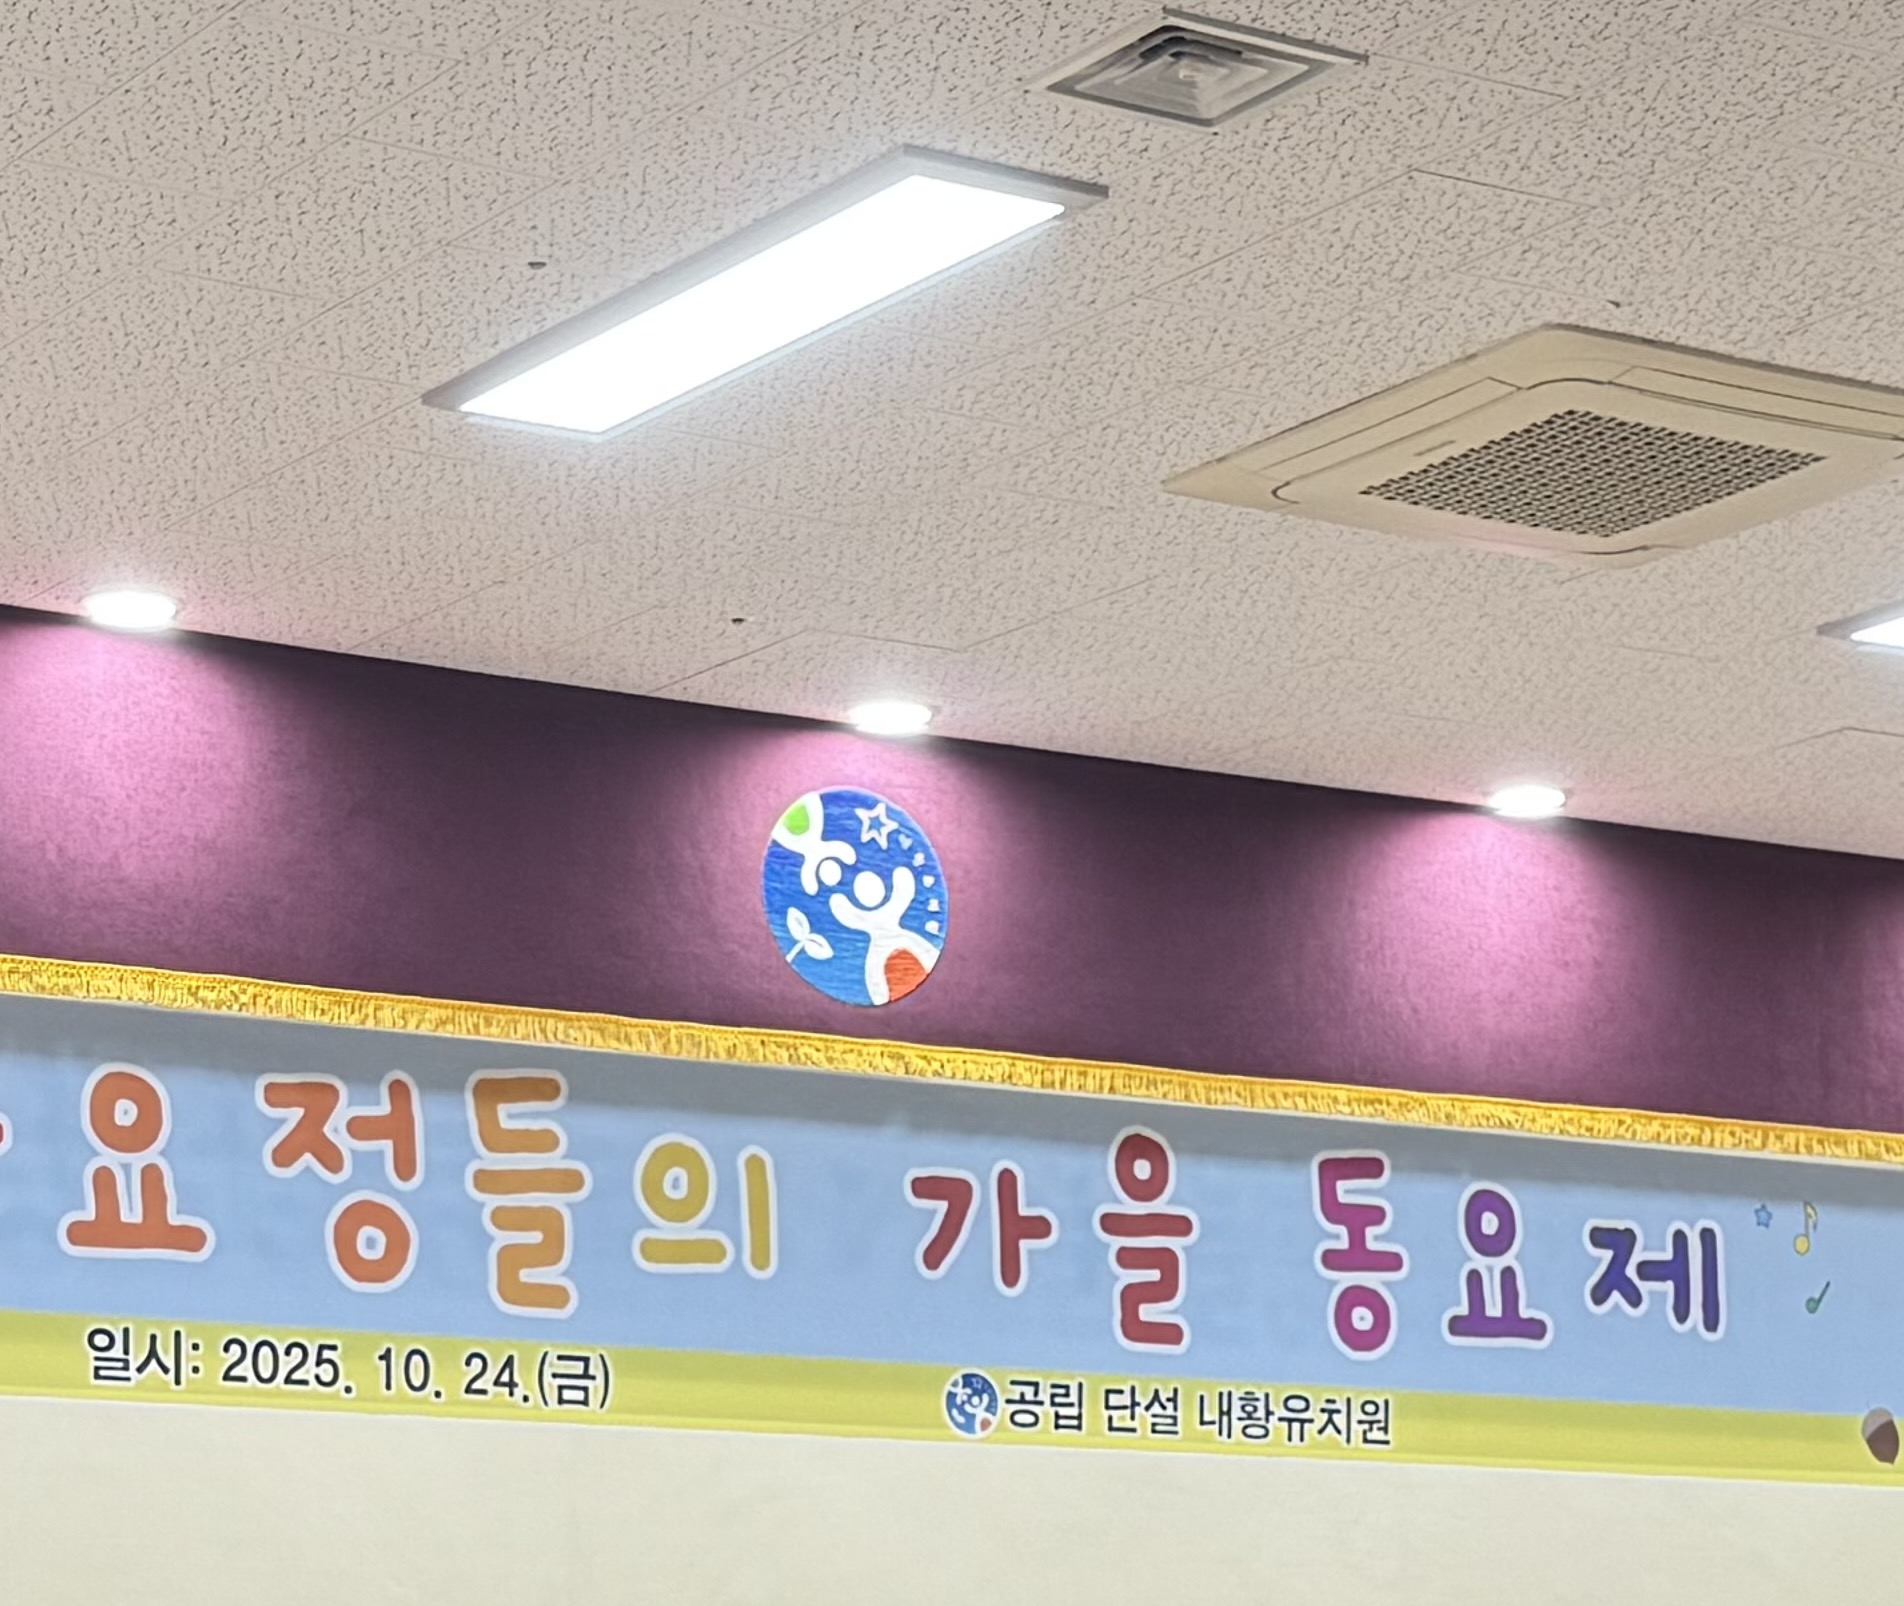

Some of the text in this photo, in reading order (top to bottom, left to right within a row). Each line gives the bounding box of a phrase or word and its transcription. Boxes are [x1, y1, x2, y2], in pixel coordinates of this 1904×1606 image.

[908, 1130, 1195, 1348] 가을
[1315, 1153, 1723, 1354] 동요제
[86, 1326, 611, 1409] 일시: 2025. 10. 24.(금)
[1004, 1378, 1391, 1446] 공립 단설 내황유치원
